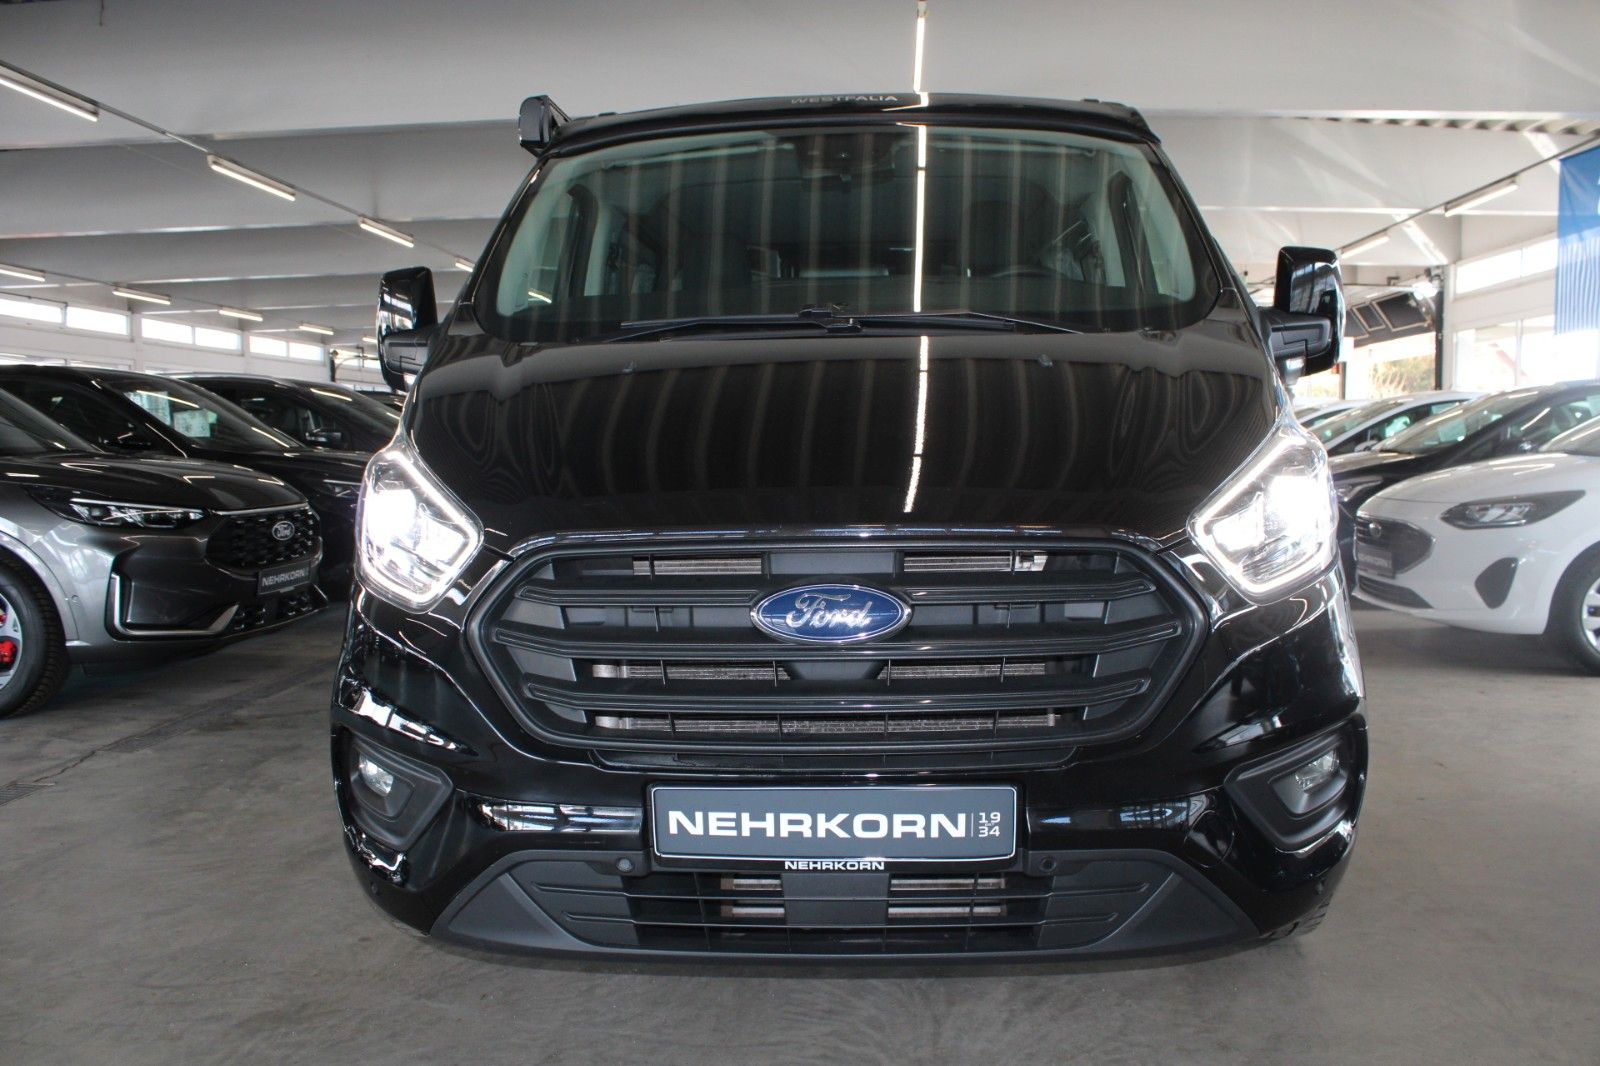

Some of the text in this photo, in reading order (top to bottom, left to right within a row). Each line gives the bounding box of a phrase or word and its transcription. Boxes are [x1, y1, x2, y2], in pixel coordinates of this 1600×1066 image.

[791, 95, 898, 104] WESTFALIA
[786, 593, 873, 628] Ford
[978, 811, 1001, 823] 19
[668, 811, 966, 838] NEHRKORN
[978, 825, 1001, 838] 34
[785, 861, 884, 871] NEHRKORN
